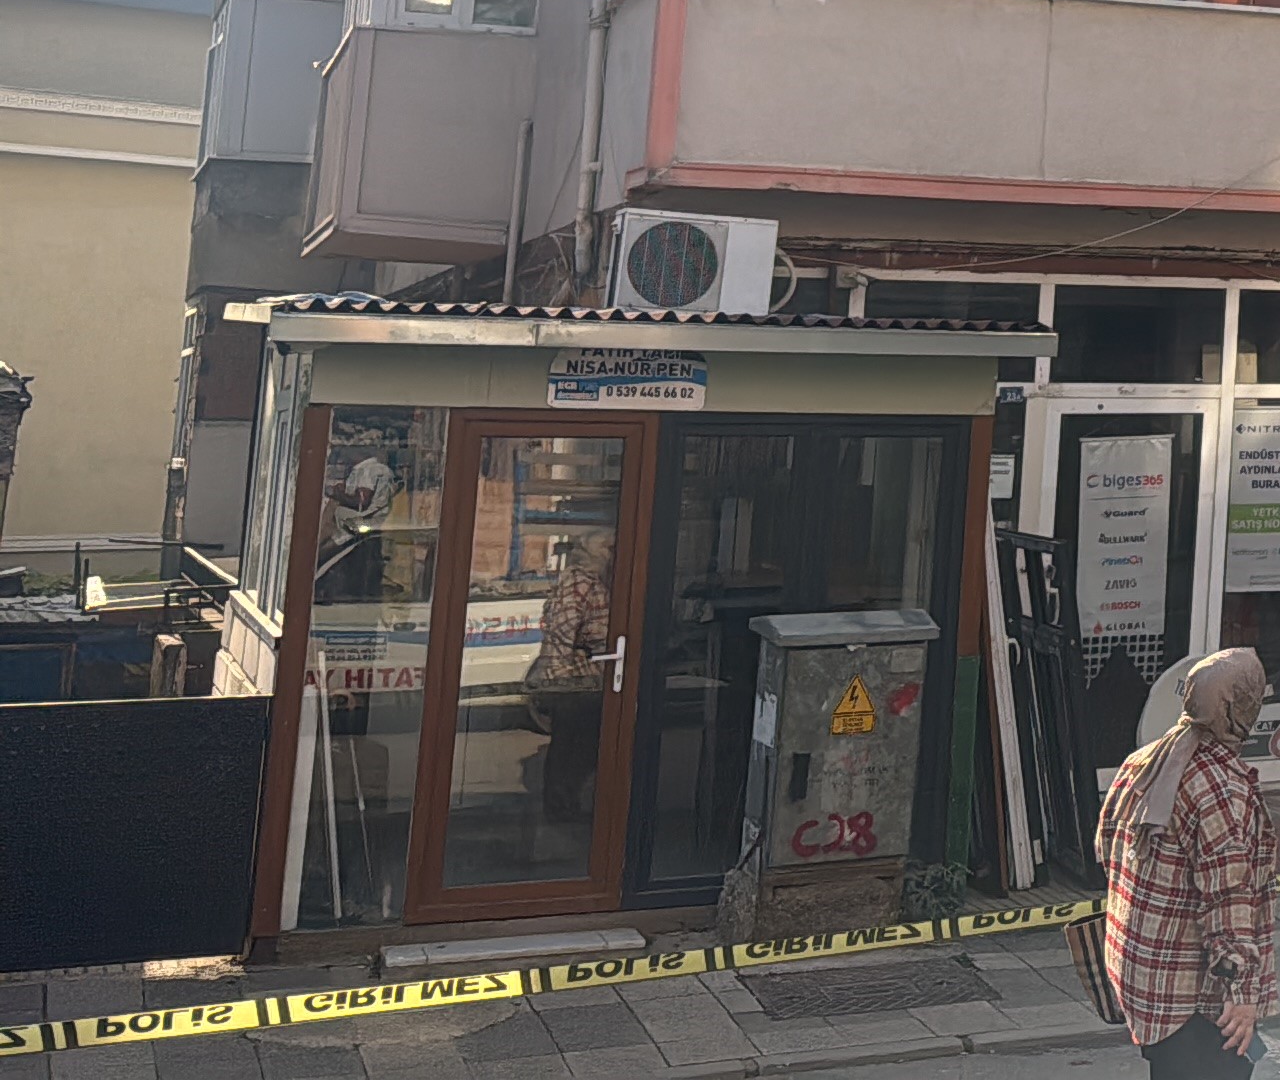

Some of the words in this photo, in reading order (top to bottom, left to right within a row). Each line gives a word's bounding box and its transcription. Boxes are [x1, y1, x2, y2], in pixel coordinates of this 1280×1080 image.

[656, 363, 692, 377] PEN
[606, 386, 613, 397] 0
[616, 385, 637, 398] 539
[640, 386, 661, 398] 445
[664, 387, 678, 399] 66
[680, 387, 695, 400] 02
